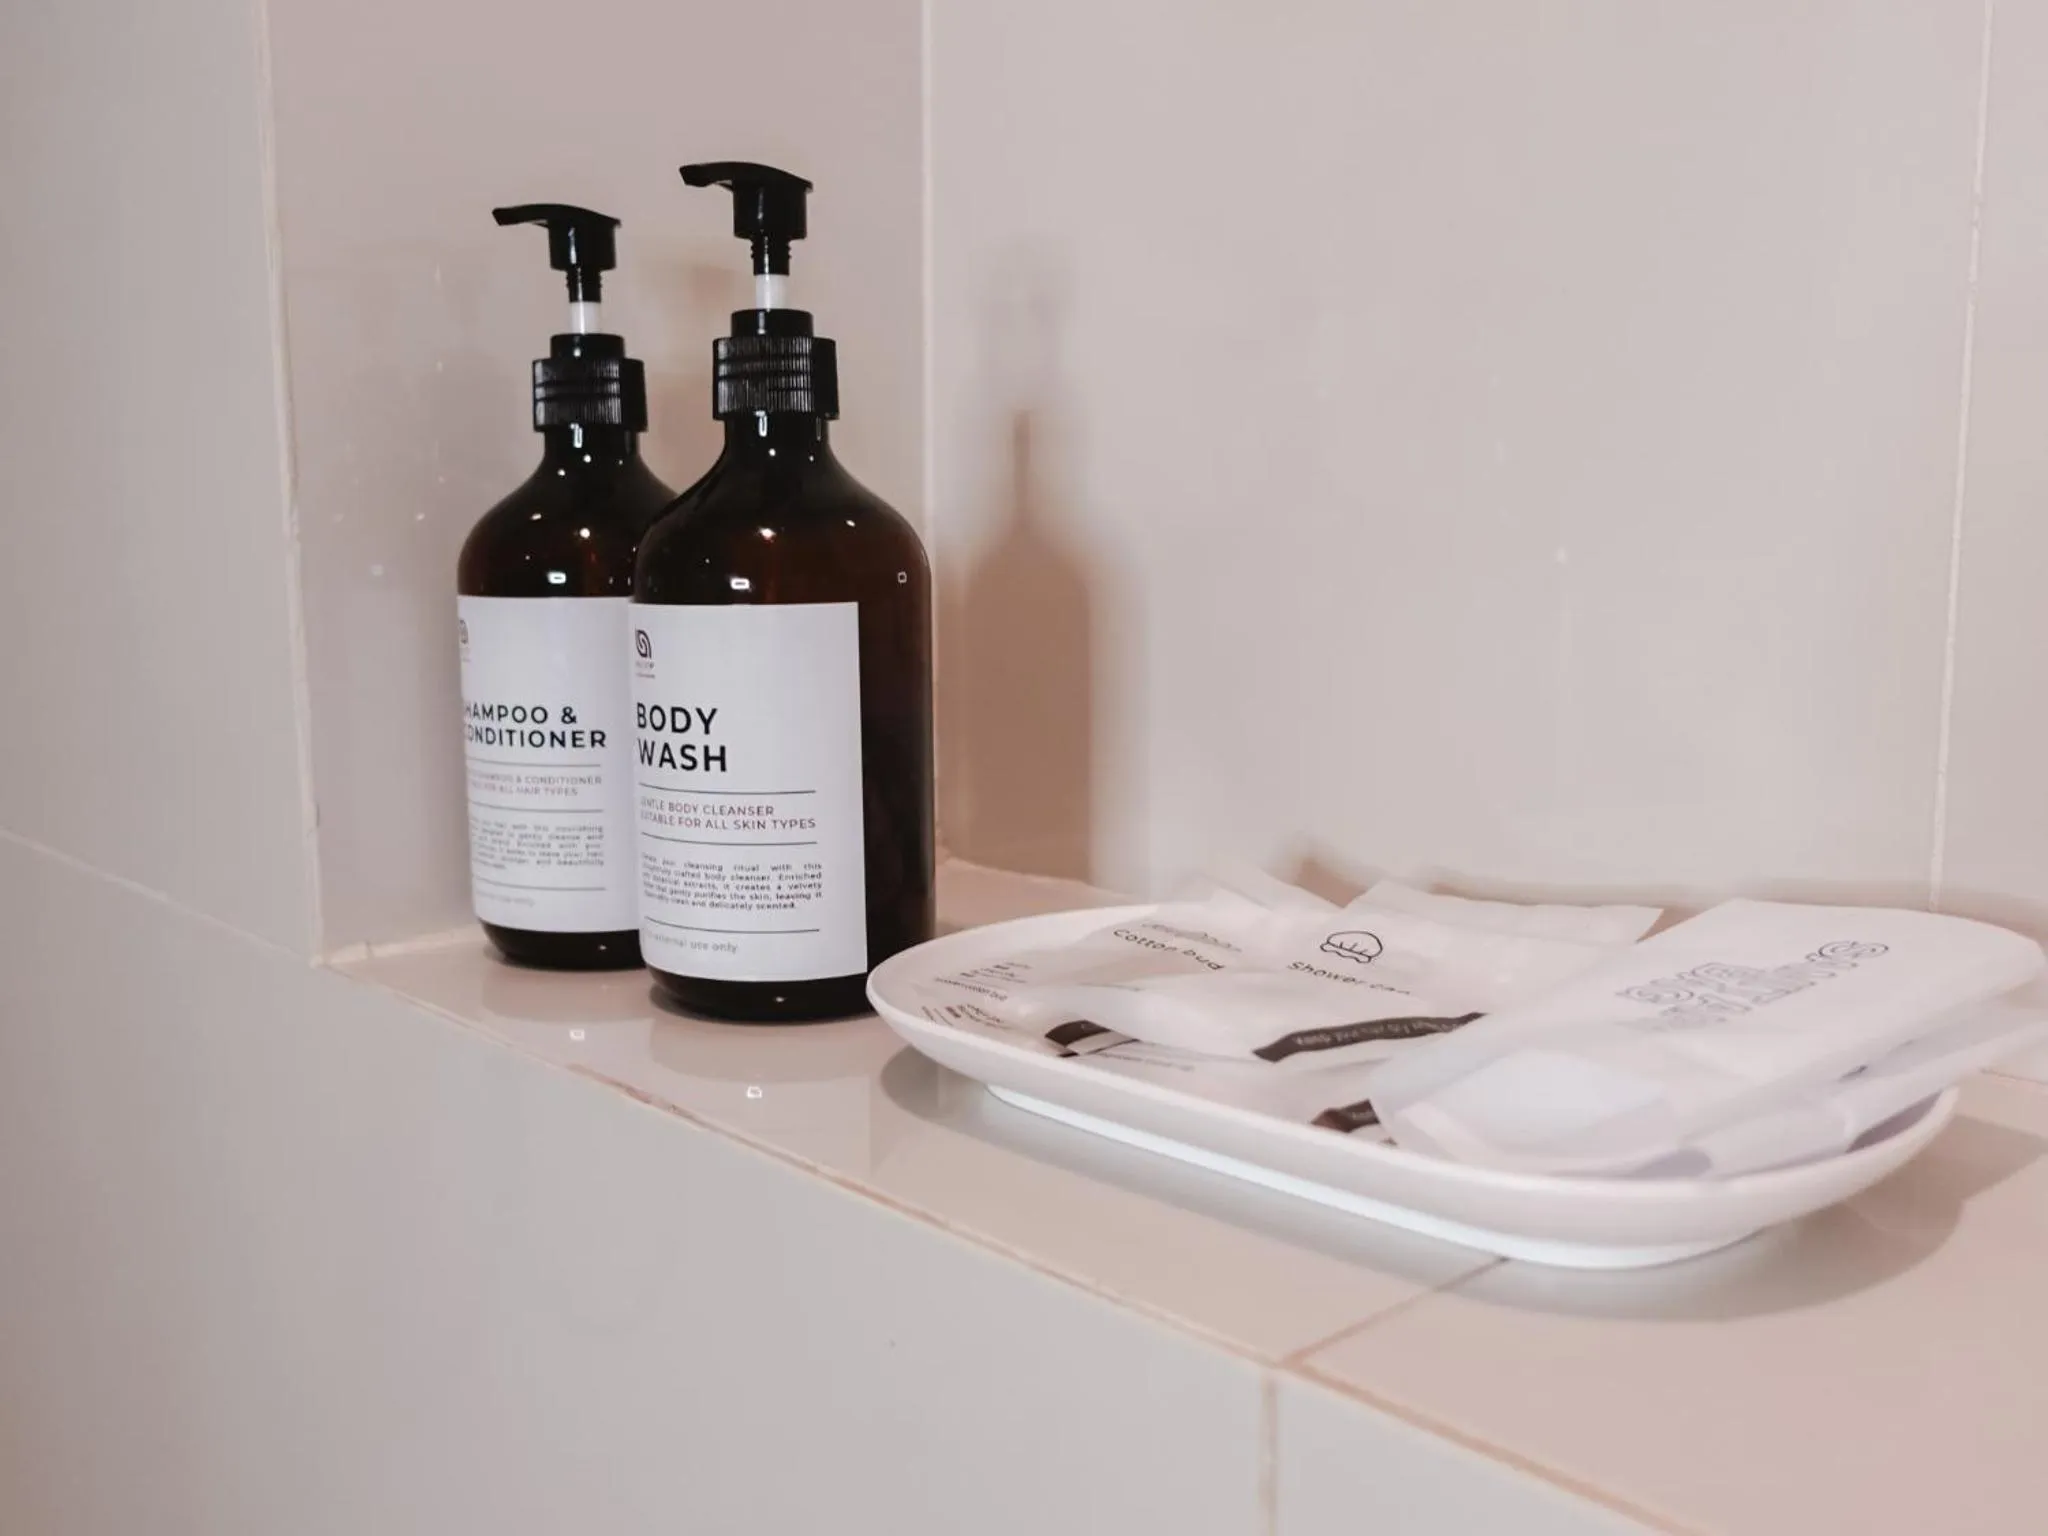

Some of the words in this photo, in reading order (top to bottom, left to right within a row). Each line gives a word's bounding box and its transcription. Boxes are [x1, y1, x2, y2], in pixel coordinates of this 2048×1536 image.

[561, 706, 577, 724] &
[637, 702, 717, 735] BODY
[465, 724, 606, 748] ONDITIONER
[638, 738, 727, 772] WASH
[525, 776, 602, 785] CONDITIONER
[668, 802, 699, 815] BODY
[703, 804, 775, 817] CLEANSER
[678, 817, 701, 828] FOR
[705, 819, 728, 830] ALL
[734, 819, 766, 831] SKIN
[772, 818, 816, 830] TYPES
[683, 860, 723, 872] cleansing
[770, 863, 793, 872] with
[803, 863, 822, 871] this
[704, 871, 727, 882] body
[778, 871, 822, 881] Enriched
[735, 883, 771, 892] creates
[788, 882, 823, 892] velvety
[730, 892, 746, 901] the
[775, 892, 812, 902] leaving
[709, 901, 753, 911] delicately
[1113, 928, 1178, 952] Cotton
[712, 941, 738, 955] only
[1286, 960, 1367, 985] Shower
